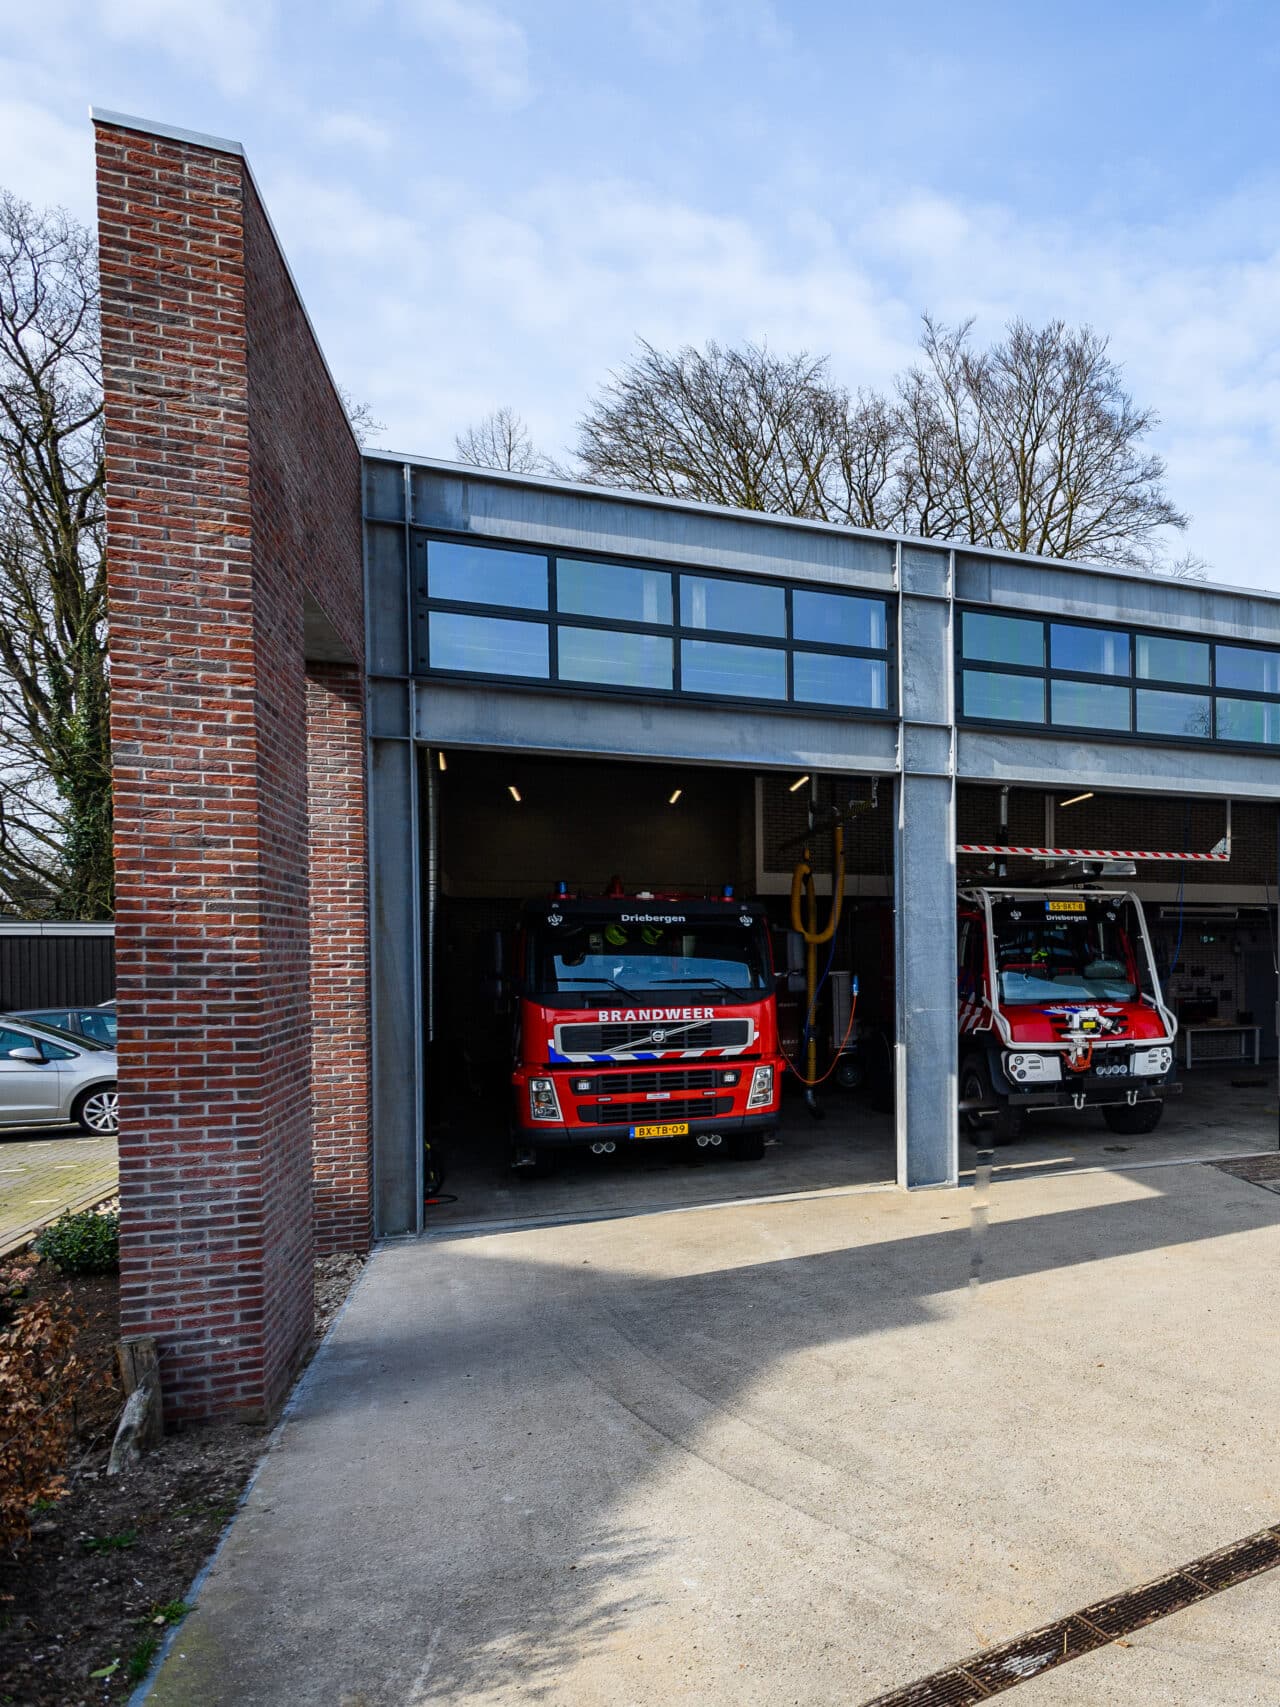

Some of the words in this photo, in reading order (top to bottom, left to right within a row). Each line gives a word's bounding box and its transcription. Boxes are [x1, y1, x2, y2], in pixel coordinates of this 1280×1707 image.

[620, 914, 686, 924] Driebergen
[1046, 914, 1088, 922] Driebergen
[598, 1008, 715, 1022] BRANDWEER
[639, 1125, 686, 1136] BX-TB-09
